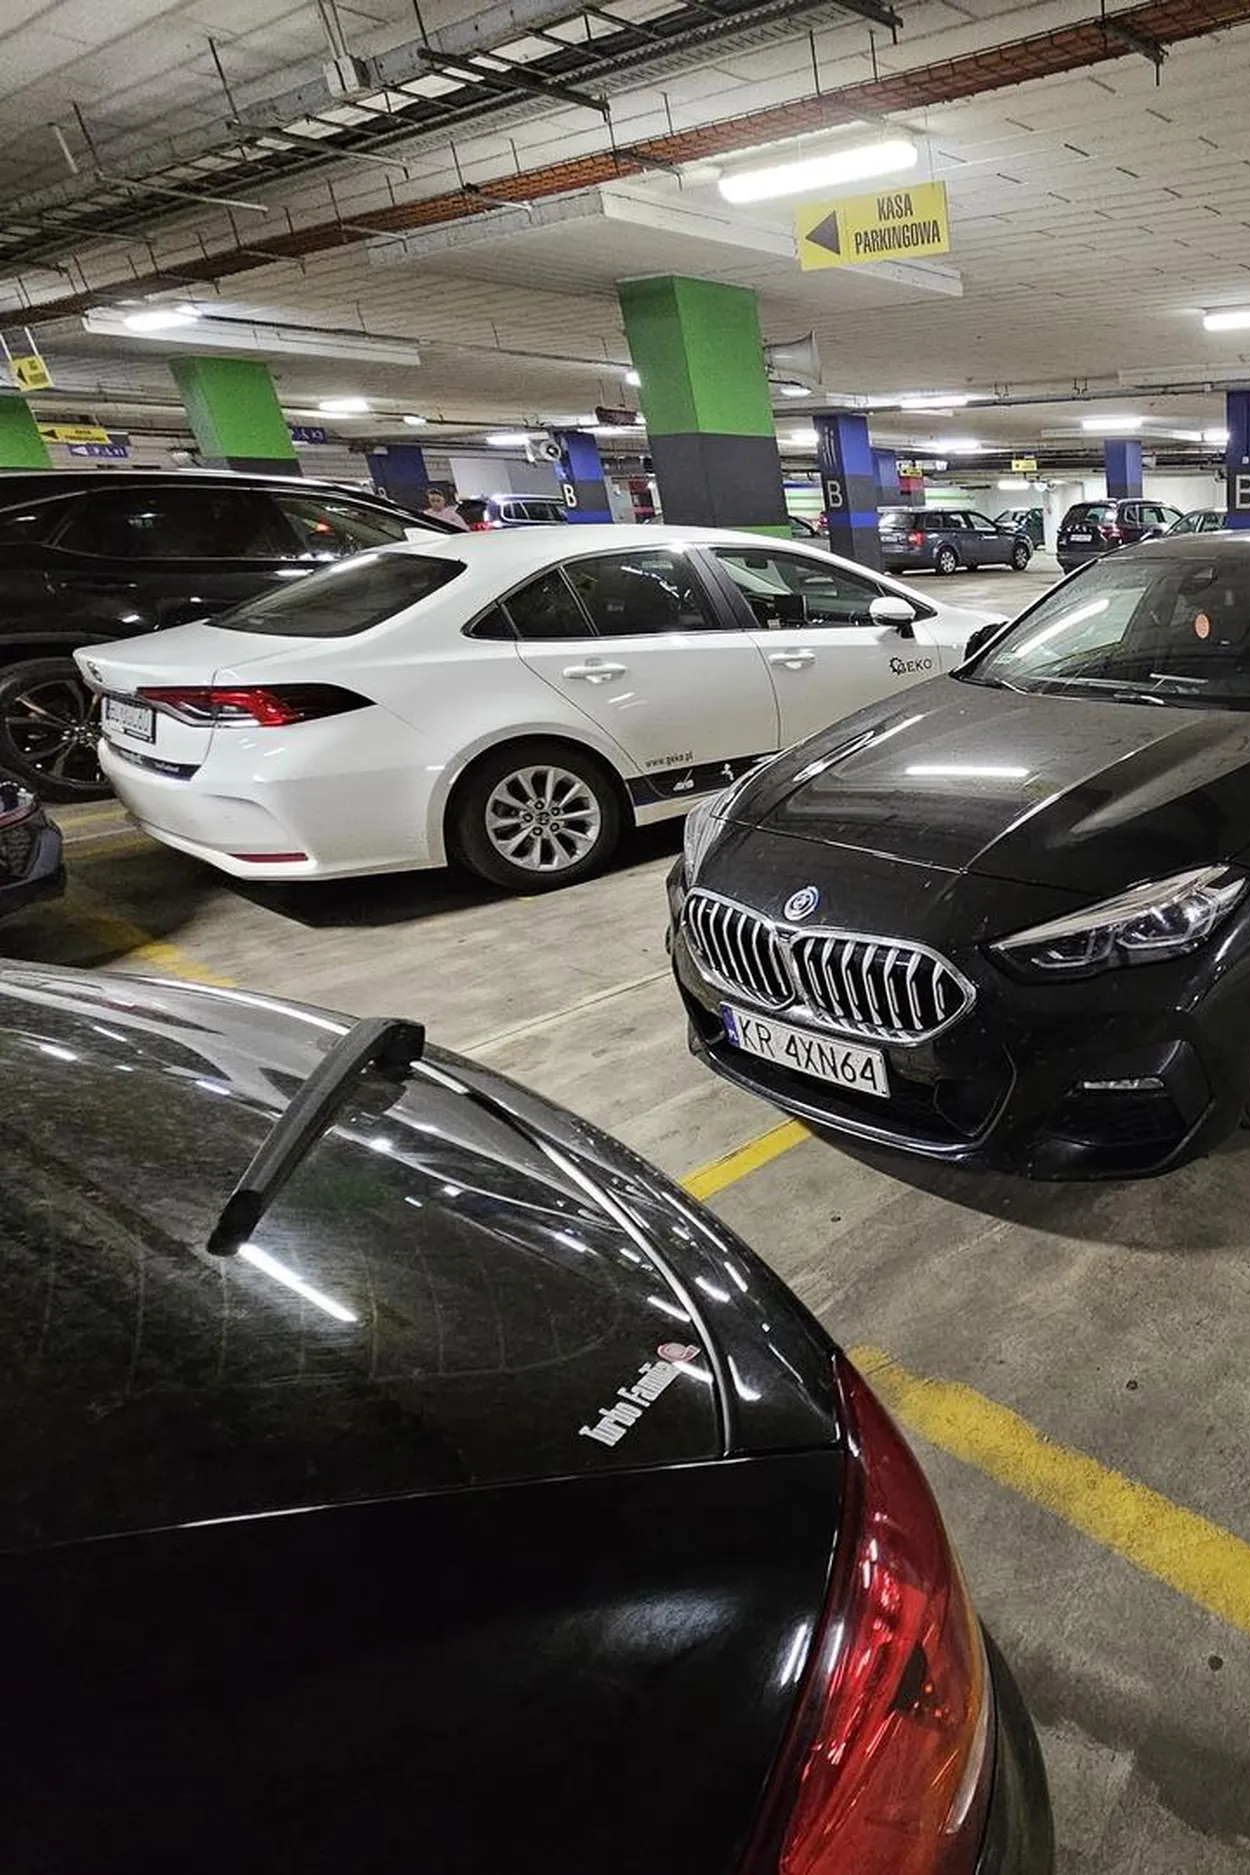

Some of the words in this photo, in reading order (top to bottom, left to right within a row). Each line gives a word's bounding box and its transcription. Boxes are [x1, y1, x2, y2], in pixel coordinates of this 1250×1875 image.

[877, 193, 914, 221] KASA
[854, 220, 941, 255] PARKINGOWA
[563, 484, 577, 507] B
[827, 480, 843, 508] B
[738, 1015, 776, 1058] KR
[785, 1034, 878, 1090] 4XN64
[578, 1401, 643, 1447] Turbo
